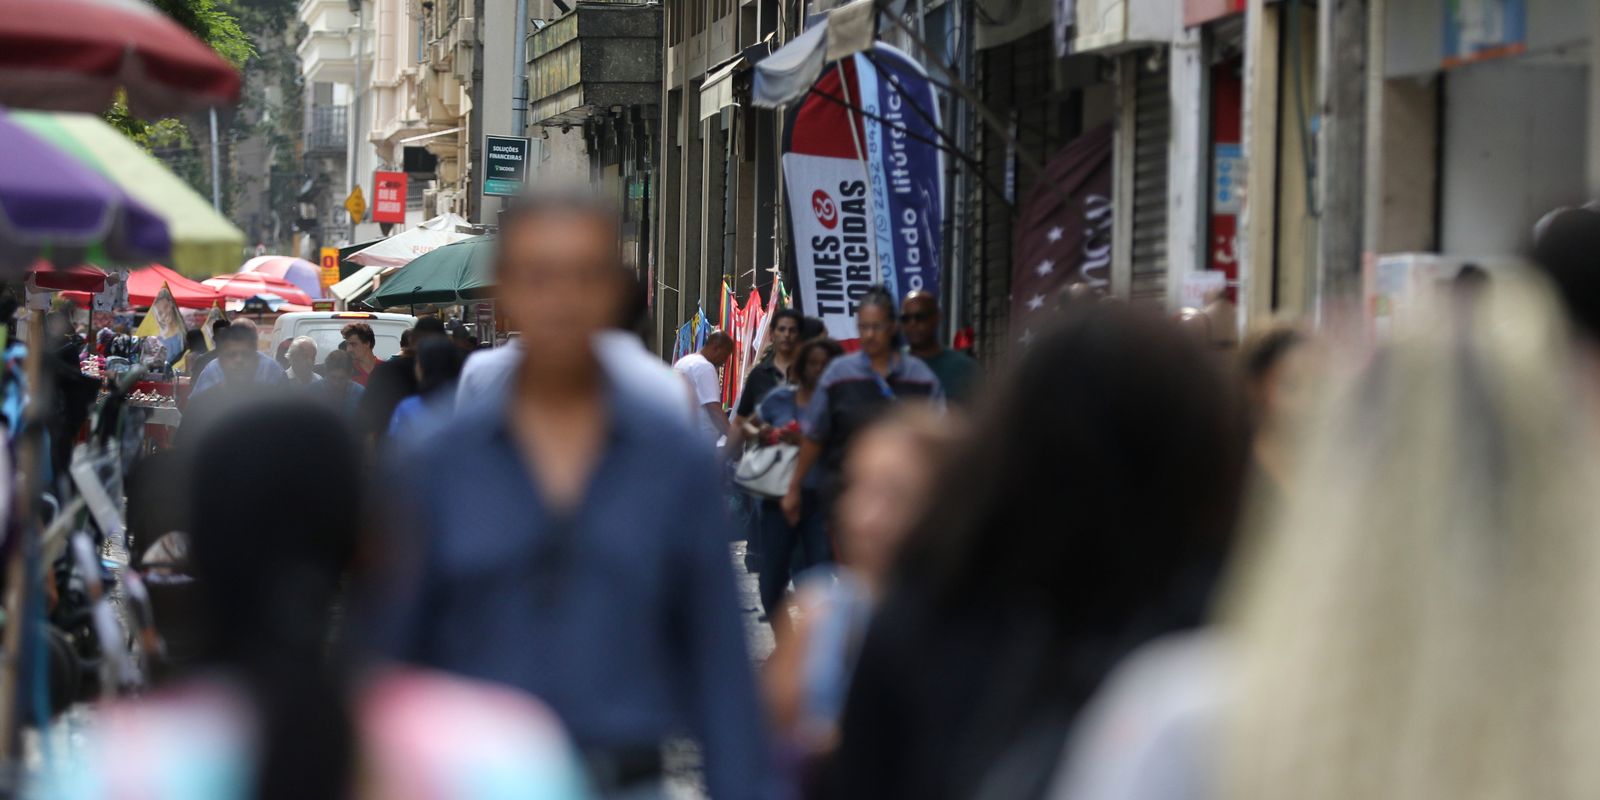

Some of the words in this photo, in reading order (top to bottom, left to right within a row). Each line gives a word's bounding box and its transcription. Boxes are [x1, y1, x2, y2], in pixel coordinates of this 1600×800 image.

[489, 153, 522, 161] FINANCEIRAS
[493, 145, 519, 153] SOLUÇÕES
[885, 74, 912, 193] litúrgico
[811, 235, 844, 318] TIMES
[839, 180, 871, 317] TORCIDAS
[899, 208, 924, 292] olado
